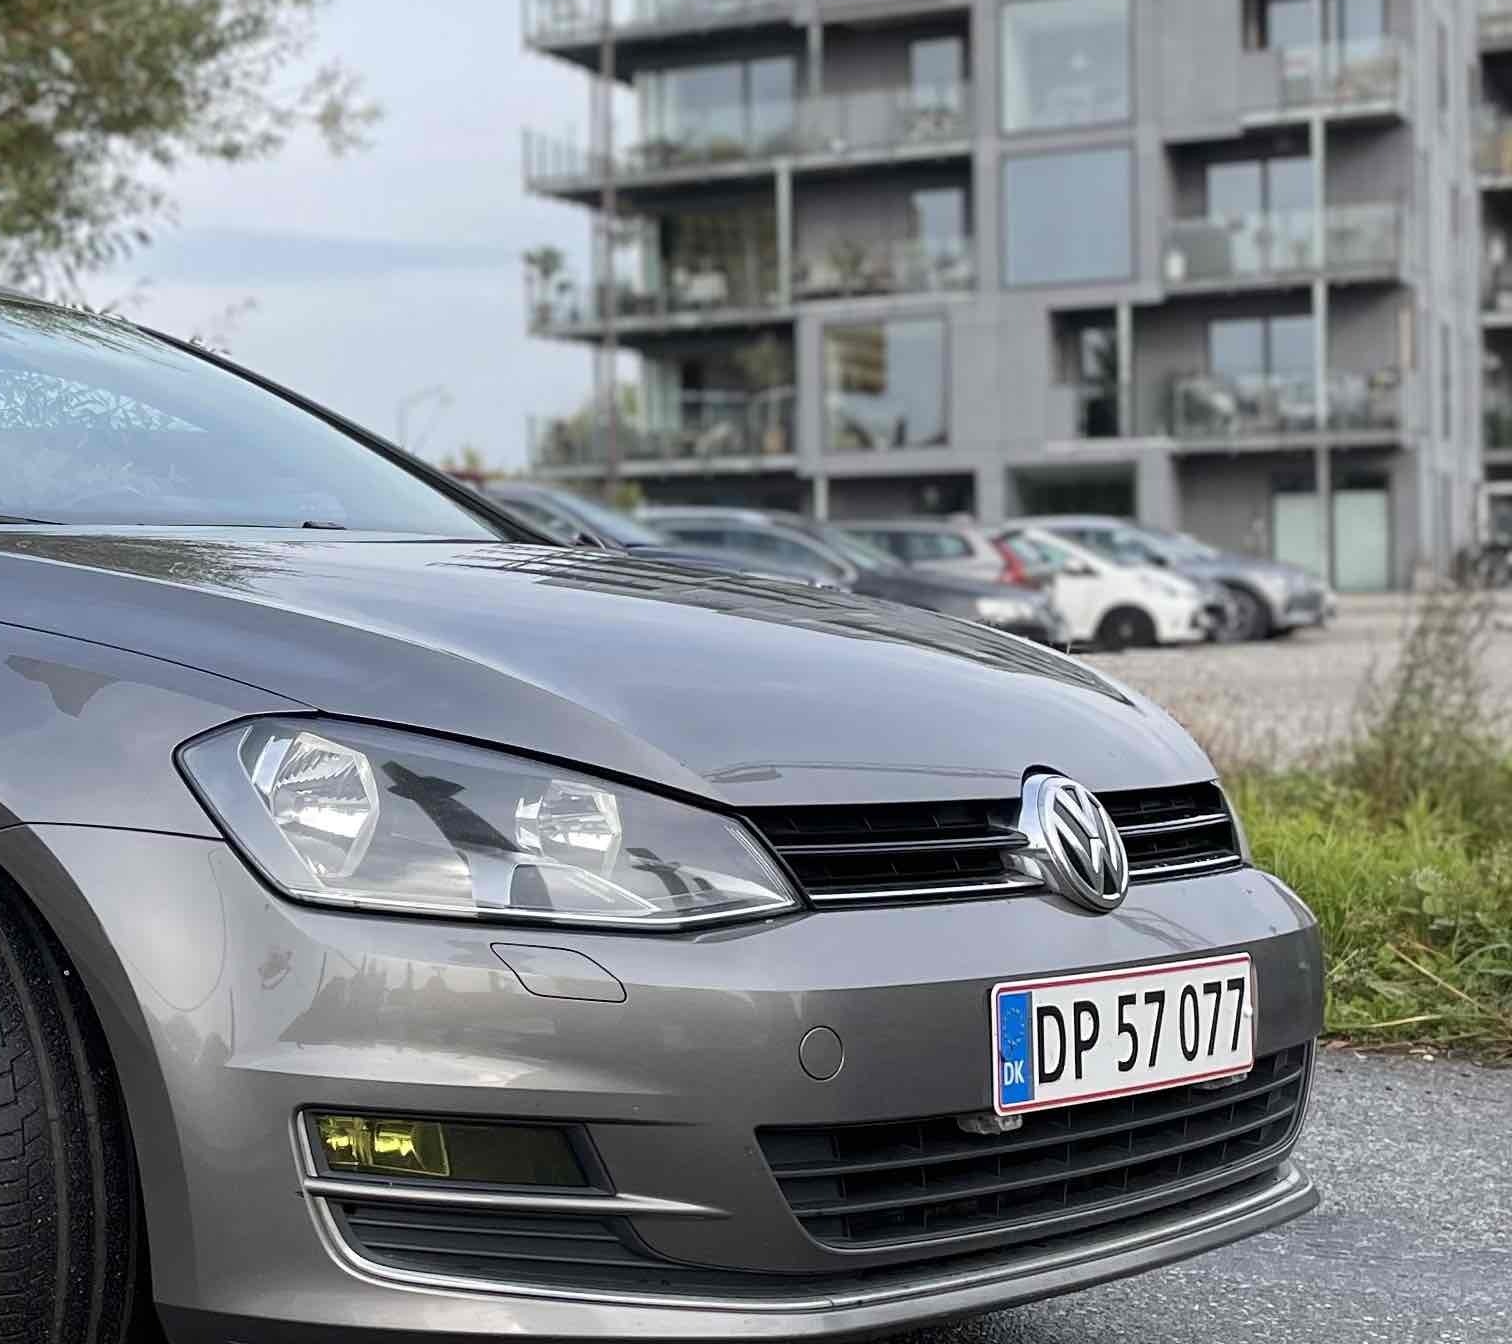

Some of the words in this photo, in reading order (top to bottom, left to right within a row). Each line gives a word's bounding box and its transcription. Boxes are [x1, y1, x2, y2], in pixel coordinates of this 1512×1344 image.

[1037, 1000, 1100, 1084] DP
[1117, 989, 1167, 1072] 57
[1179, 976, 1246, 1062] 077
[1003, 1059, 1025, 1086] DK
